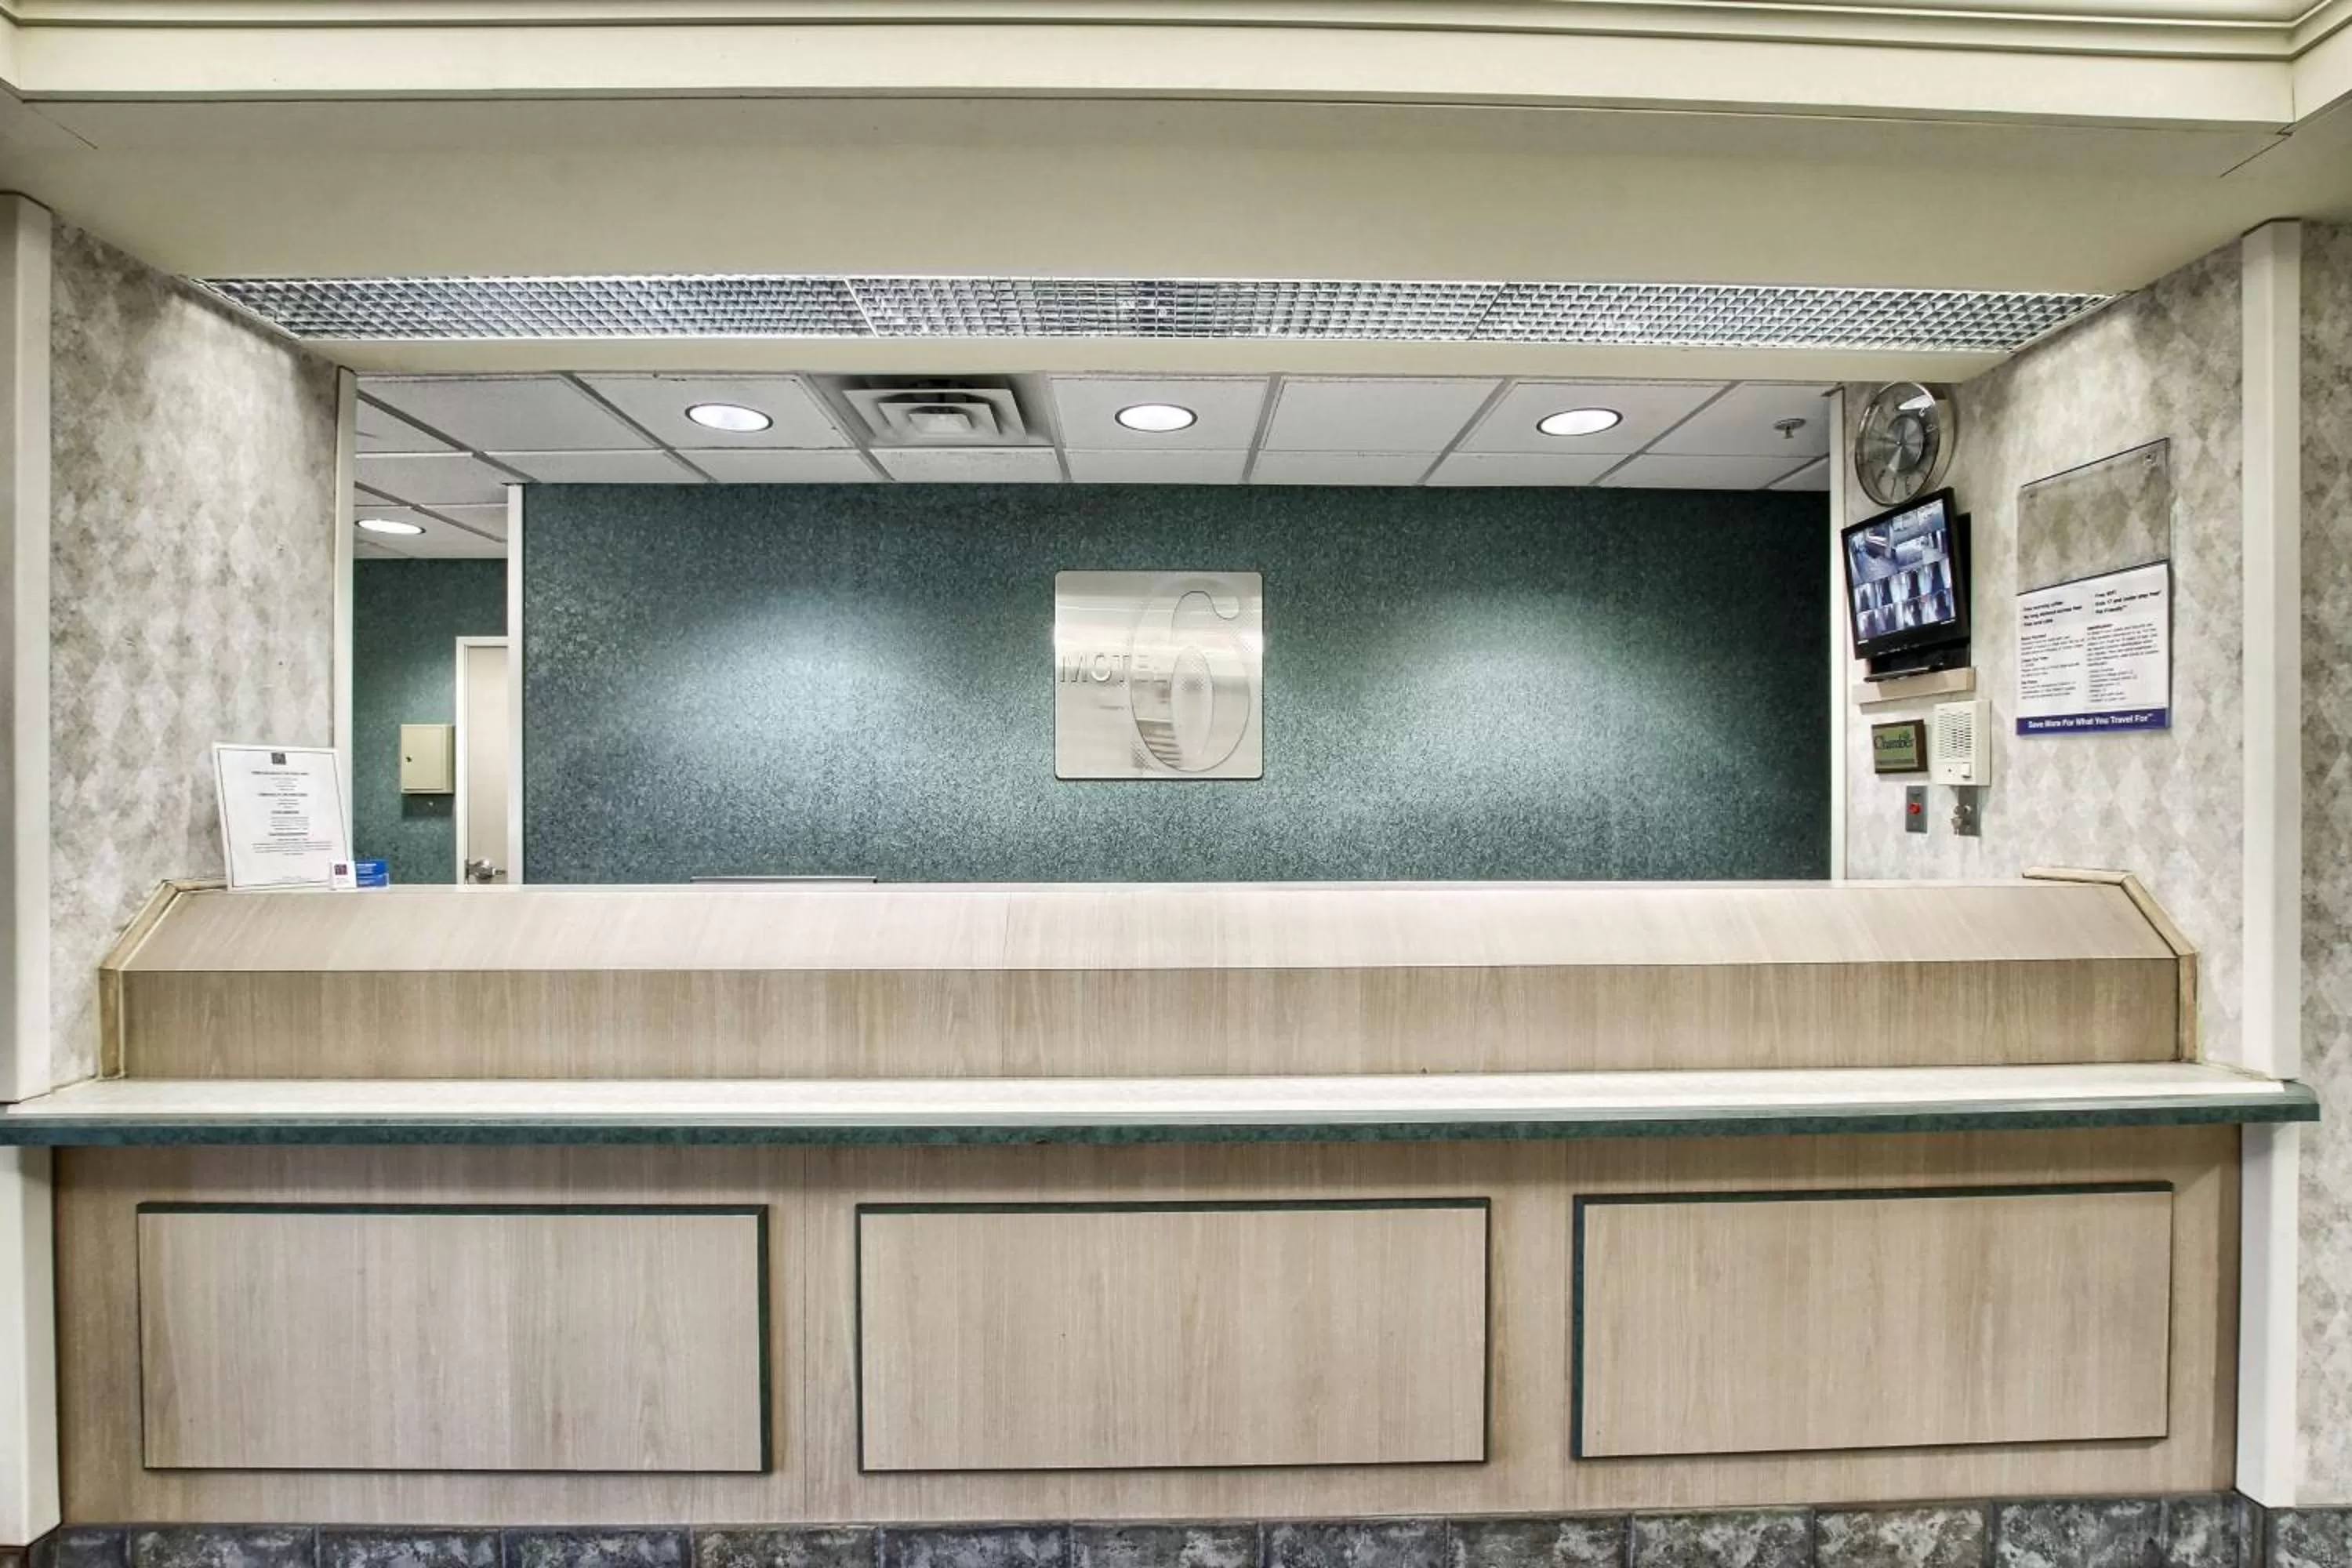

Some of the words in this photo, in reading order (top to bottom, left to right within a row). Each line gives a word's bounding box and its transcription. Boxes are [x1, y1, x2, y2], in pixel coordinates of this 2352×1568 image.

[2028, 720, 2043, 728] Save
[2062, 718, 2074, 727] For
[2075, 717, 2094, 726] What
[2096, 717, 2109, 725] You
[2110, 715, 2133, 724] Travel
